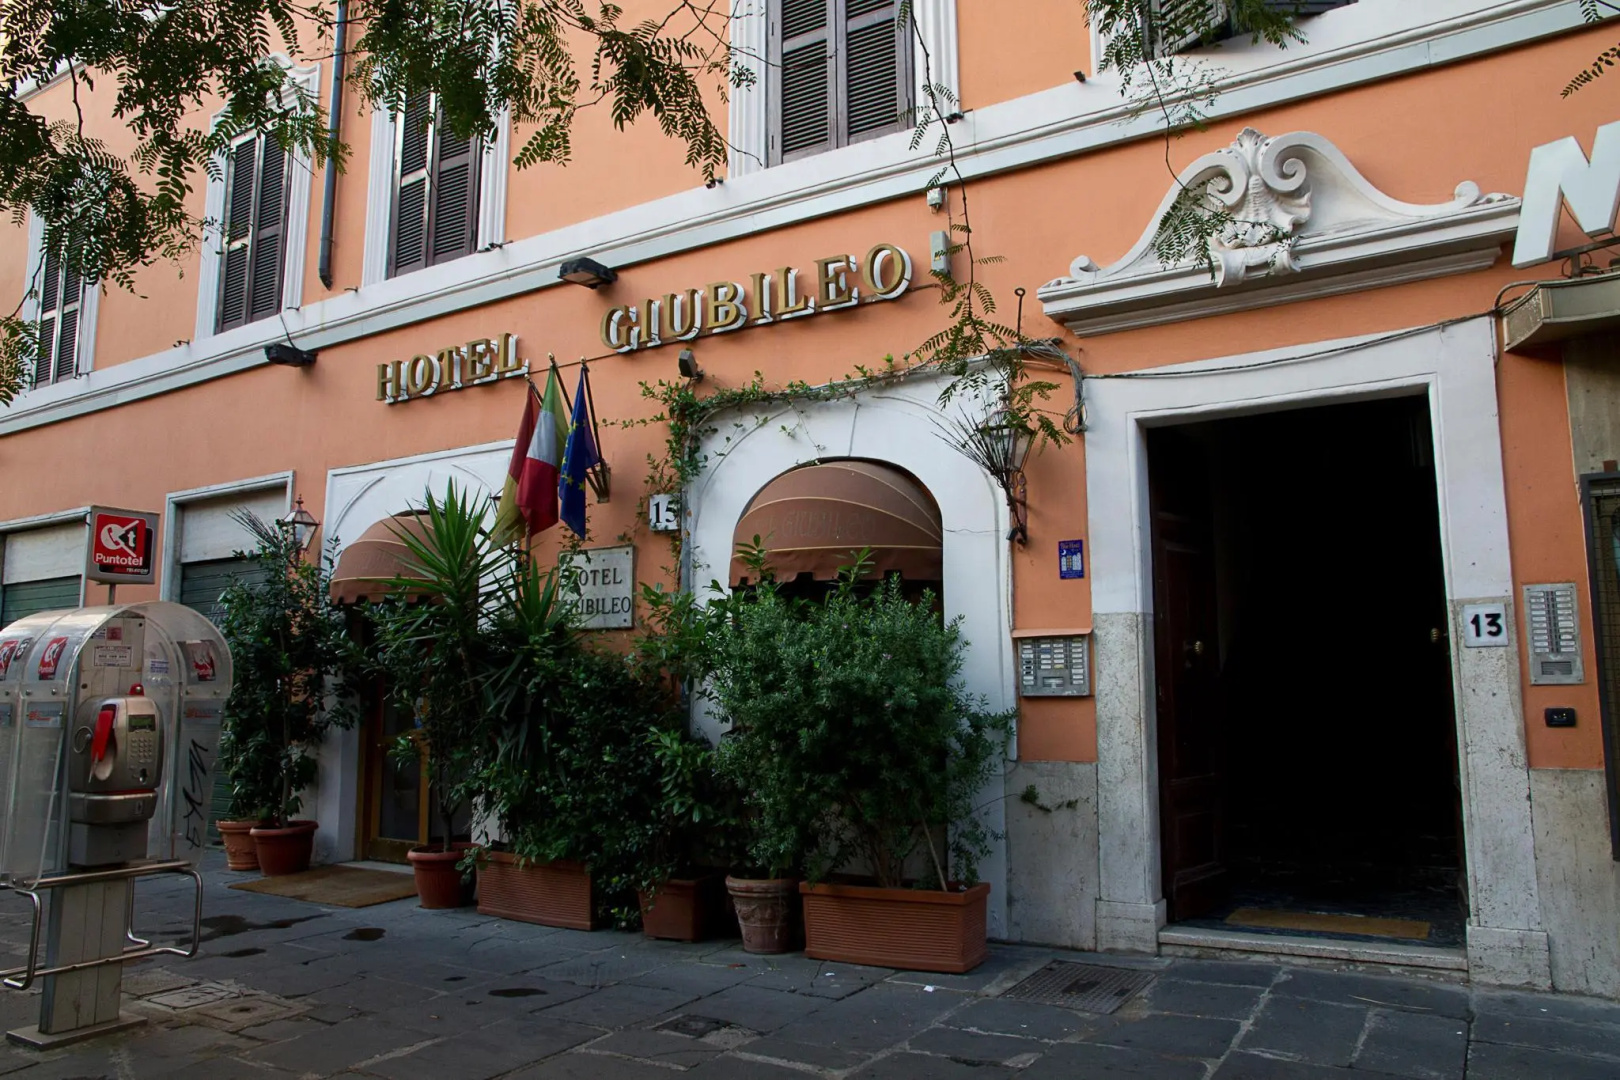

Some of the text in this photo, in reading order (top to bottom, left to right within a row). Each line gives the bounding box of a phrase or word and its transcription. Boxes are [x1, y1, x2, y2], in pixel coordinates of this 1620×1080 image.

[376, 243, 913, 403] HOTEL GIUBILEO
[652, 500, 678, 524] 15
[95, 552, 143, 566] Puntotel
[568, 567, 623, 586] OTEL
[561, 596, 631, 616] UBILEO
[1470, 613, 1503, 638] 13
